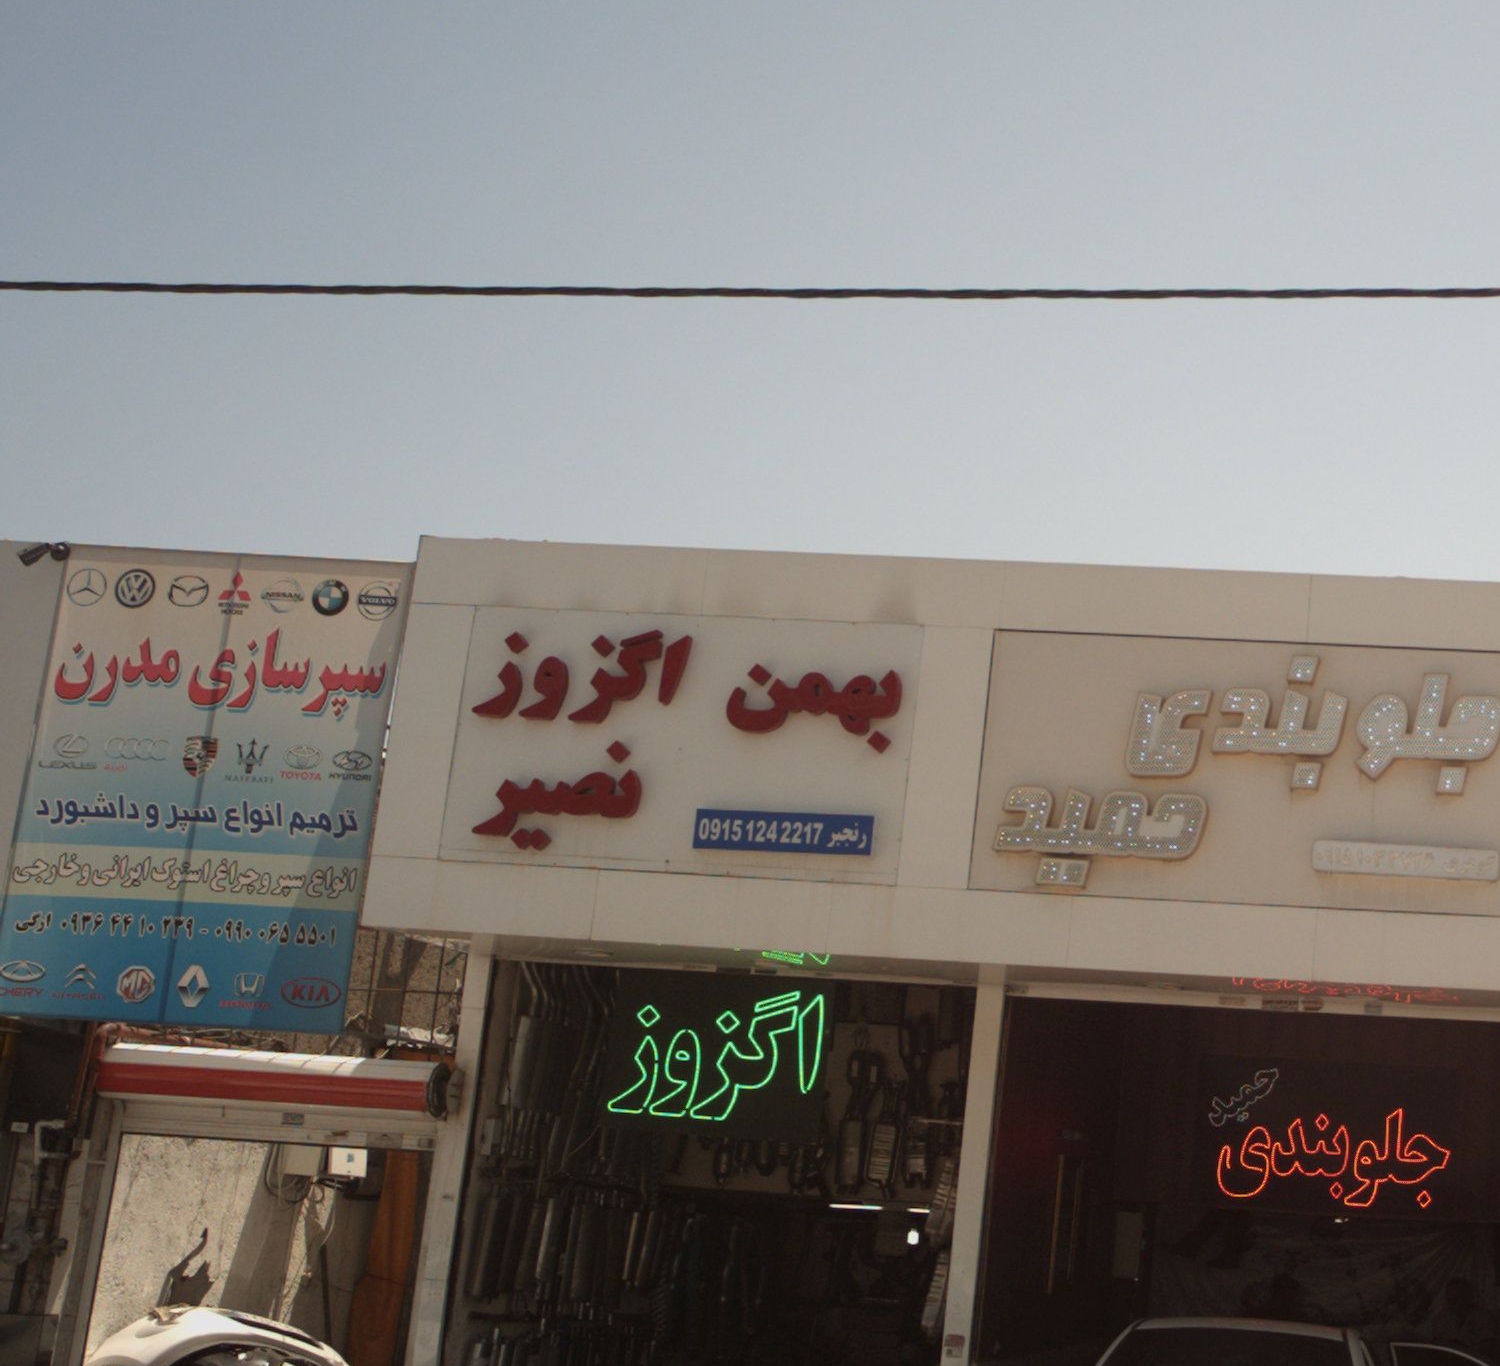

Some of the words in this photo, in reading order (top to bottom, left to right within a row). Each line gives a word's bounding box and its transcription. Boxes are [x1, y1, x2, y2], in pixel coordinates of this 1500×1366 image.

[265, 591, 301, 600] NISSAN
[360, 596, 396, 606] VOLVO
[53, 636, 181, 703] مدرن
[471, 630, 694, 724] اگزوز
[726, 663, 903, 754] بهمن
[38, 759, 97, 770] LEXUS
[279, 770, 322, 782] TOYOTA
[328, 772, 373, 782] HYUNDAI
[35, 793, 140, 826] داشبورد
[471, 740, 643, 851] نصیر
[145, 802, 160, 828] و
[164, 803, 218, 833] سپر
[223, 799, 283, 834] انواع
[289, 808, 360, 839] ترمیم
[826, 821, 868, 849] رنجبر
[992, 786, 1209, 888] حمید
[12, 852, 82, 885] خارجی
[76, 862, 92, 886] و
[91, 854, 151, 888] ایرانی
[150, 857, 213, 891] استوک
[209, 857, 261, 896] چراغ
[257, 871, 272, 895] و
[305, 865, 358, 900] انواع
[270, 873, 307, 898] سپر
[607, 990, 825, 1122] اگزوز
